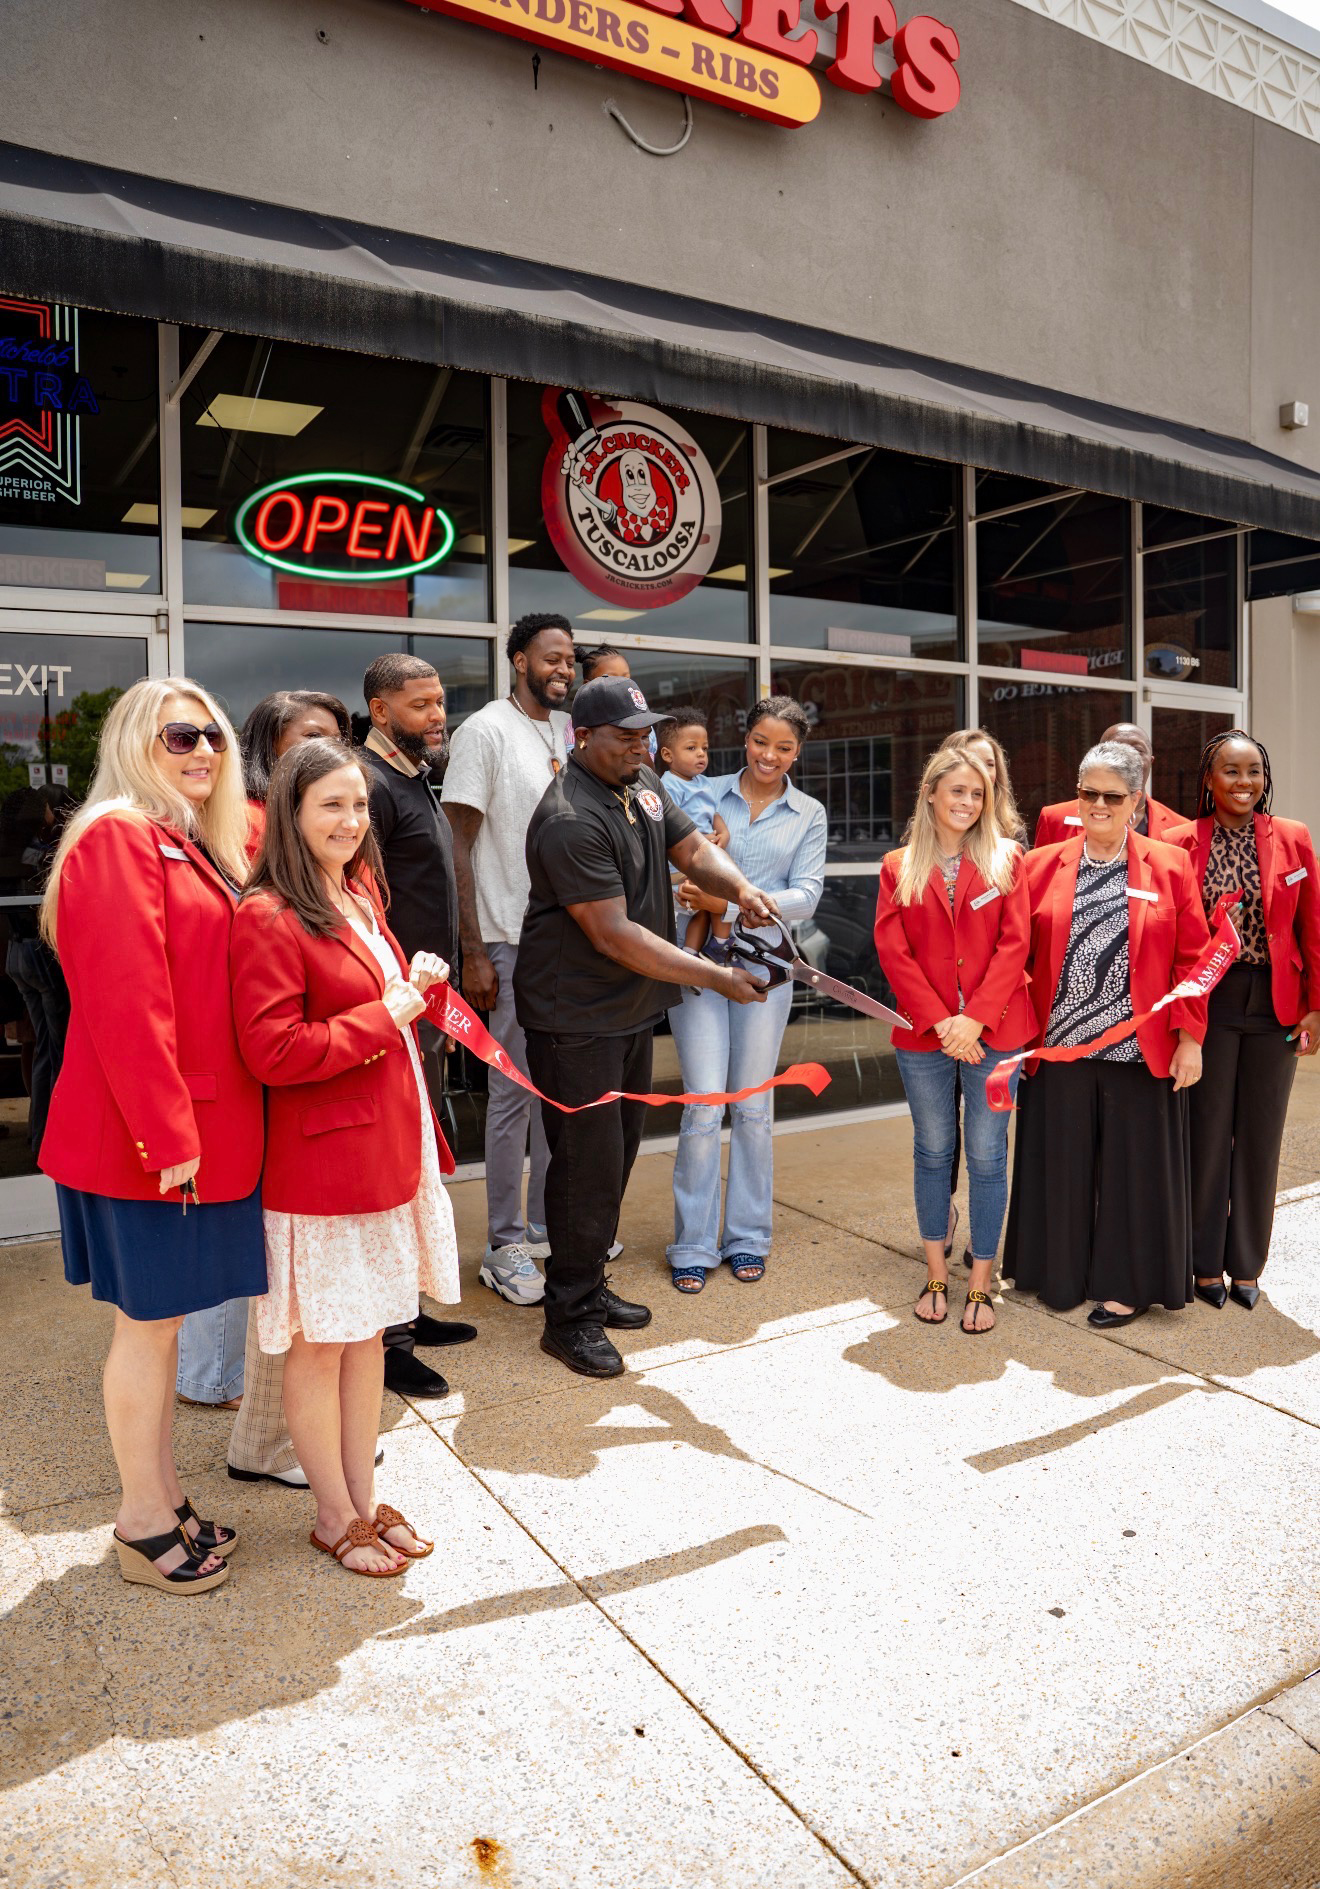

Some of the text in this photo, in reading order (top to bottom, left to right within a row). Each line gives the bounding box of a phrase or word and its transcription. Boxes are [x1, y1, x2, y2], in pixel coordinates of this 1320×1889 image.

[691, 41, 780, 100] RIBS
[23, 490, 56, 502] BEER
[255, 490, 435, 562] OPEN
[578, 506, 697, 572] TUSCALOOSA
[605, 573, 673, 591] JRCRICKETS.COM
[1175, 656, 1190, 666] 1130
[1197, 942, 1234, 986] AMBER
